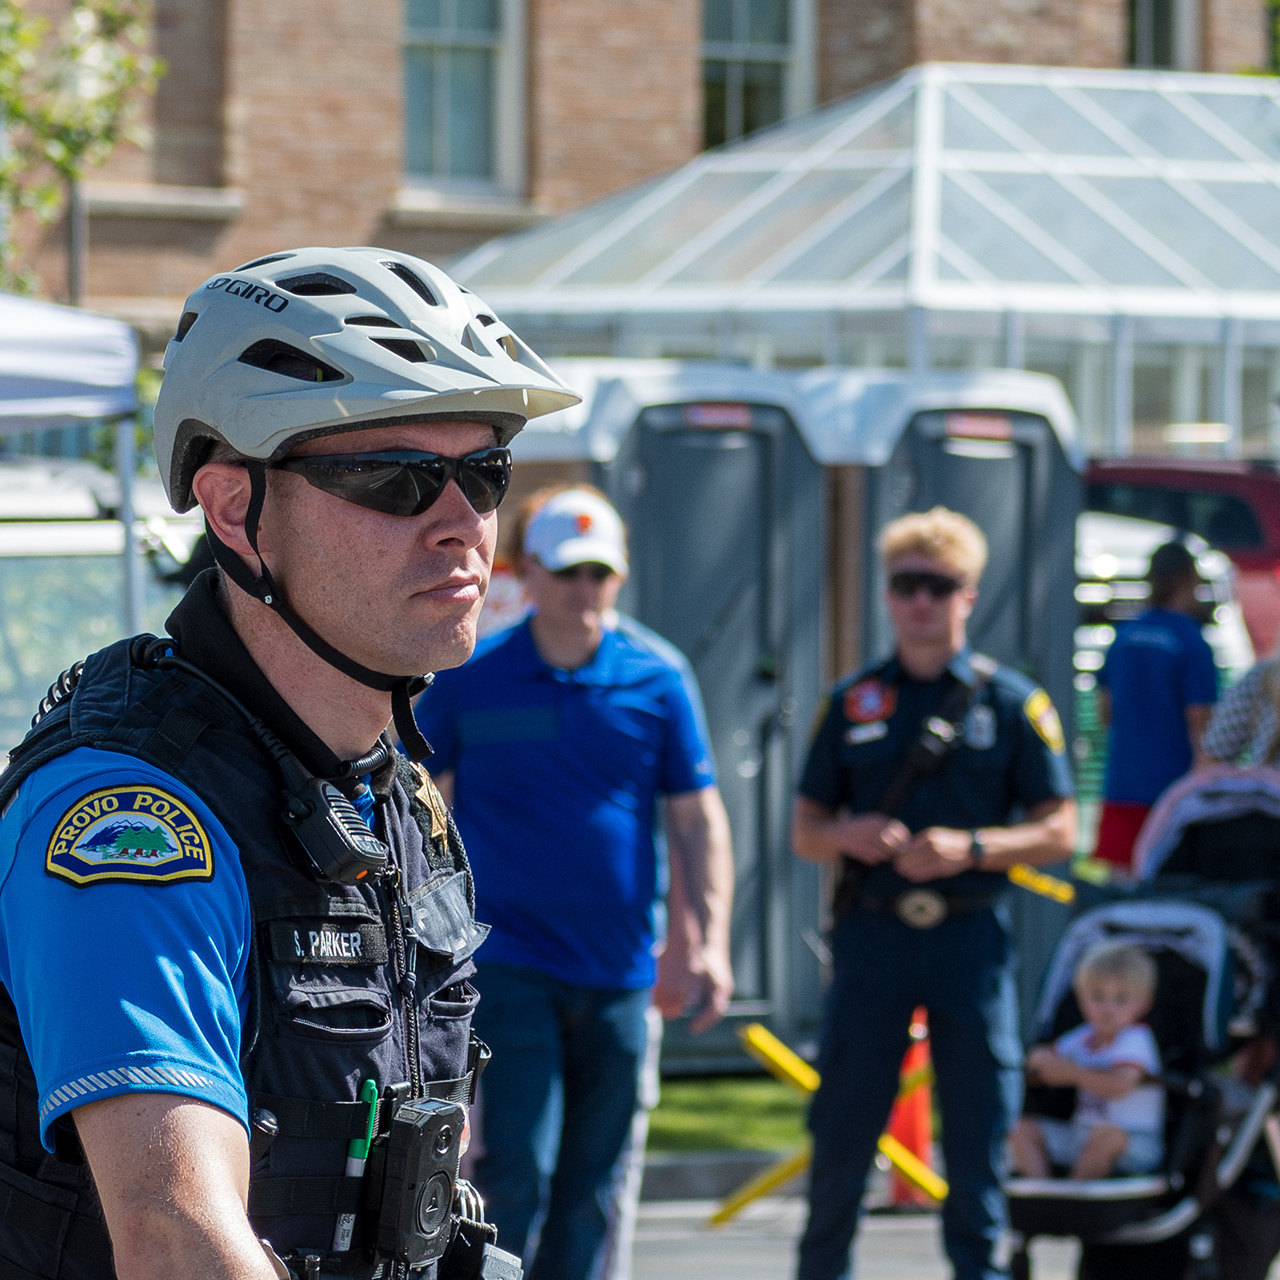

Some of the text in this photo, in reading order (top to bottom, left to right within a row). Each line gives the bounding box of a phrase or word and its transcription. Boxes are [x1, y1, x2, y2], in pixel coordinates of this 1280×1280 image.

[225, 279, 289, 313] GIRO
[53, 793, 204, 861] PROVO POLICE
[293, 930, 363, 957] S. PARKER
